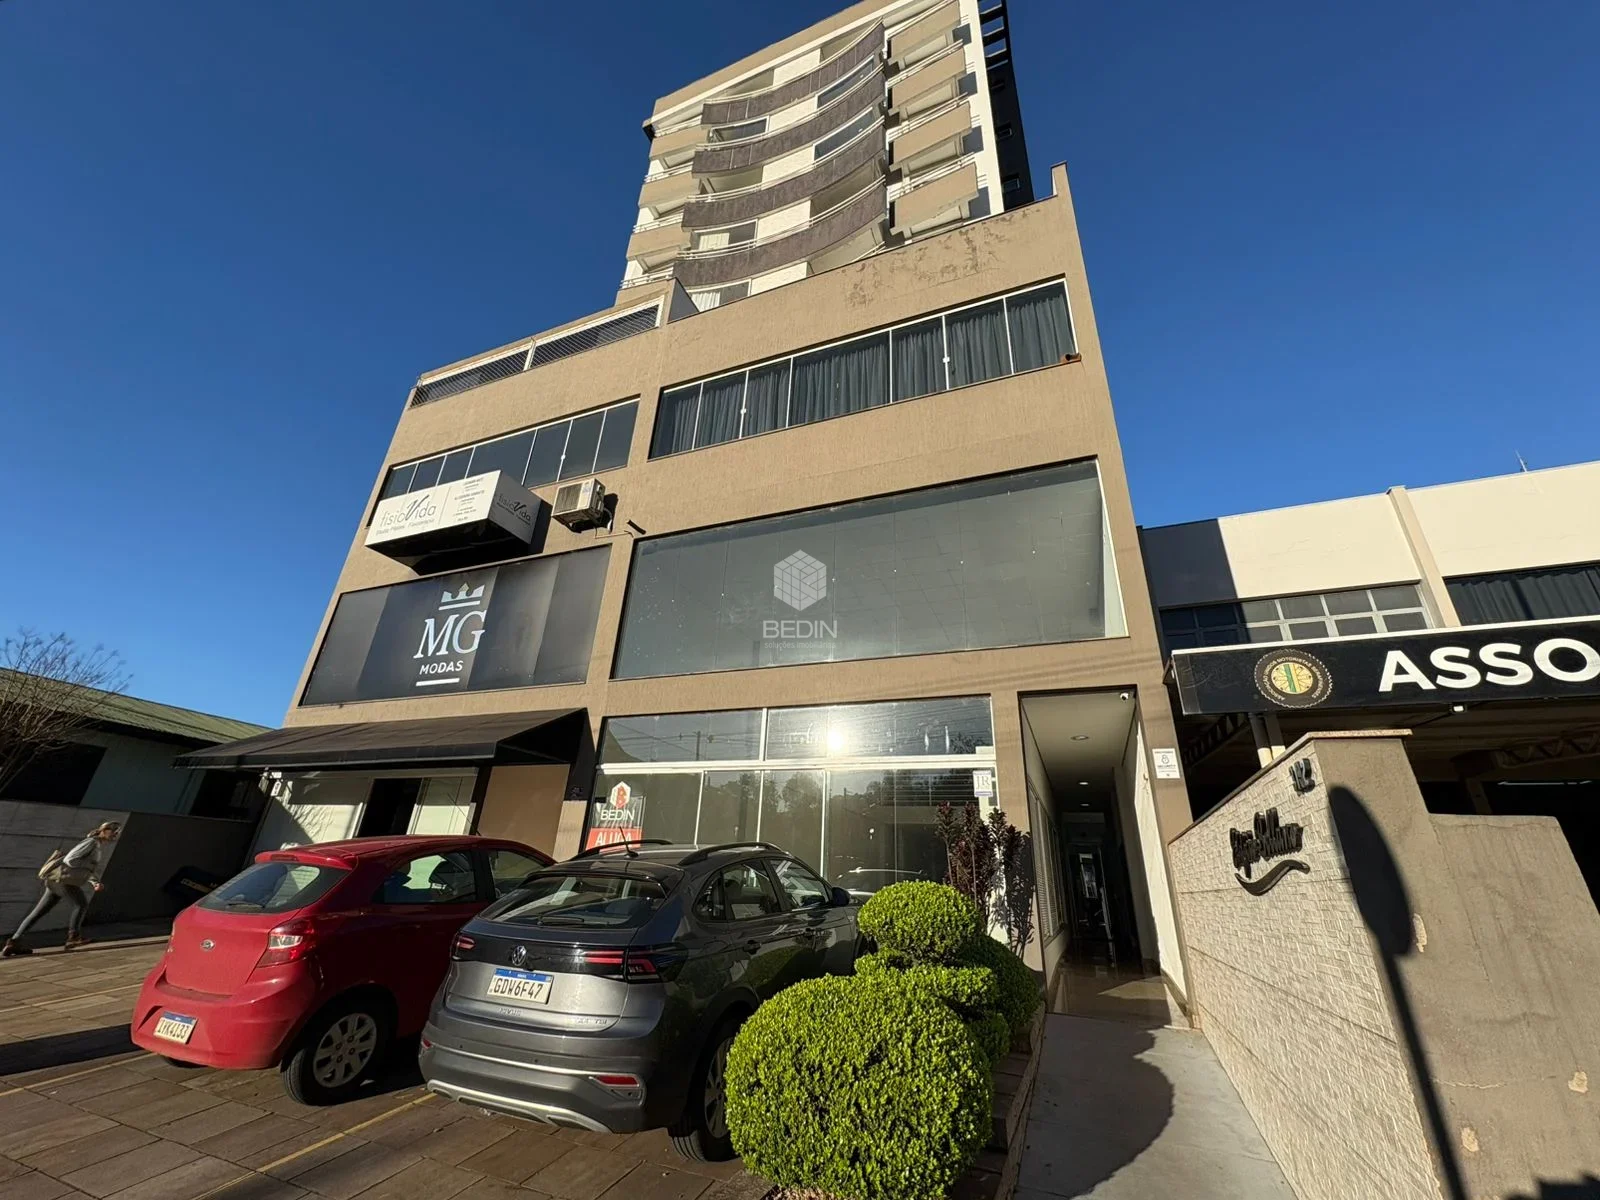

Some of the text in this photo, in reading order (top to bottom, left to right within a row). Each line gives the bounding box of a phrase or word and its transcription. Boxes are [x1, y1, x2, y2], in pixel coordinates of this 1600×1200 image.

[413, 609, 487, 659] MG
[419, 660, 464, 675] MODAS
[1379, 638, 1600, 692] ASSO
[601, 810, 635, 820] BEDIN
[493, 977, 544, 999] GDW6F47
